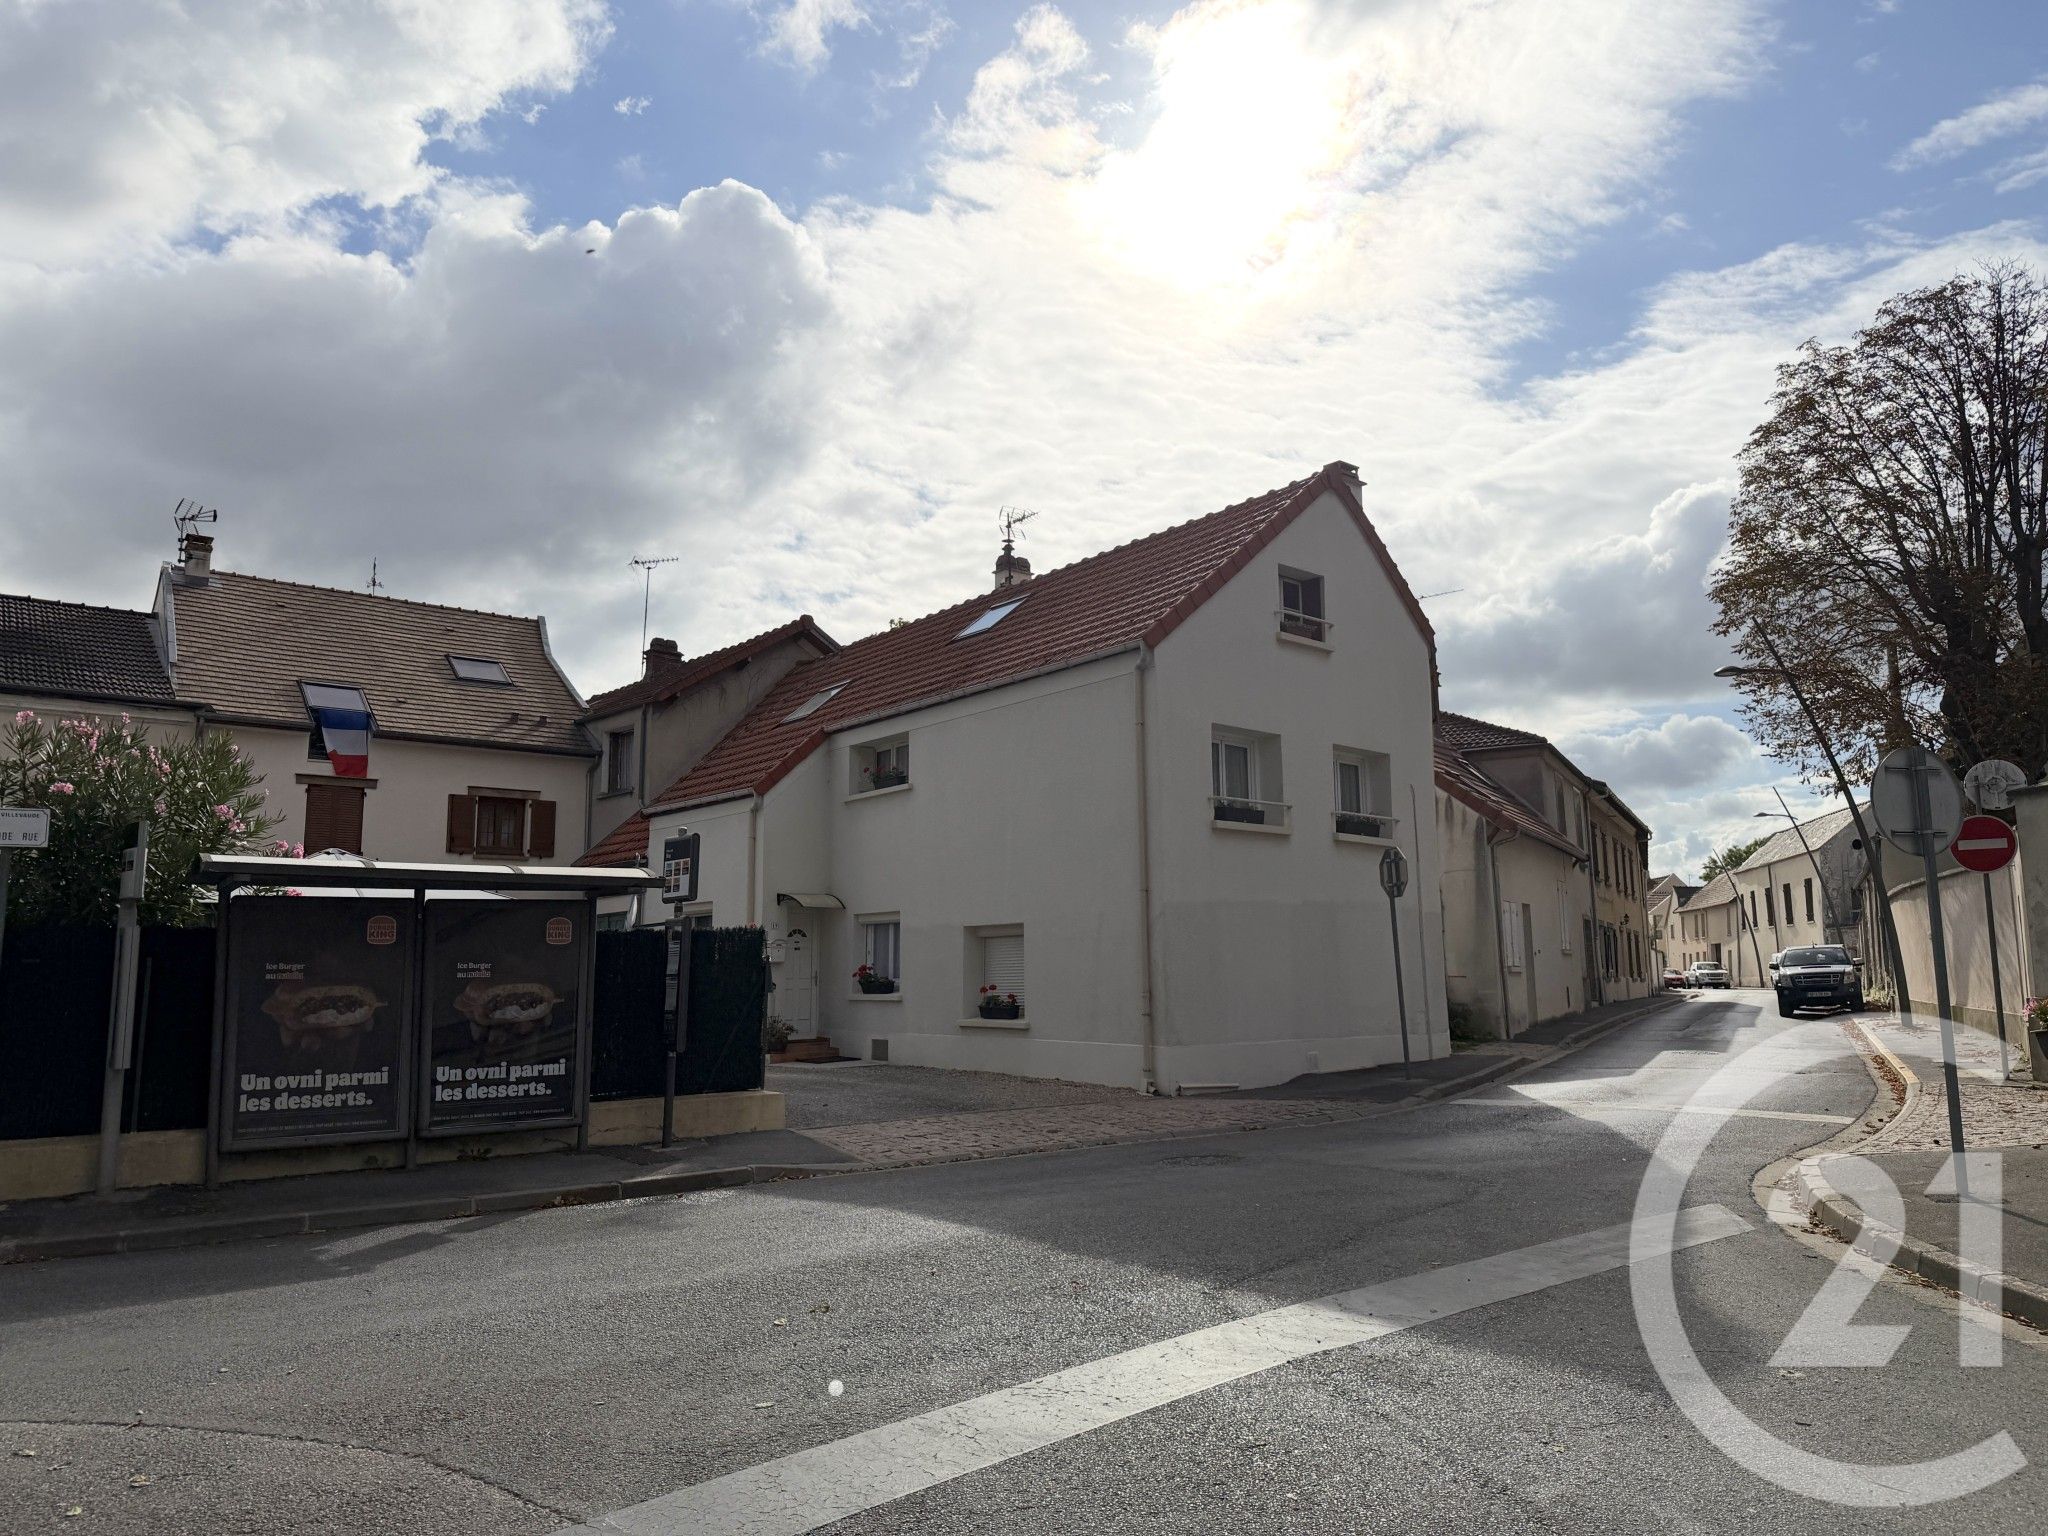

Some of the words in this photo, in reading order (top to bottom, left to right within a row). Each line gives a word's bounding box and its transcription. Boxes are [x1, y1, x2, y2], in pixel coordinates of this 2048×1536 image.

[0, 832, 13, 841] DE
[22, 832, 39, 842] RUE
[369, 931, 395, 939] KING
[548, 931, 571, 939] KING
[266, 962, 278, 970] Ice
[279, 962, 306, 972] Burger
[469, 962, 492, 970] Burger
[436, 1065, 463, 1082] Un
[465, 1061, 507, 1080] ovni
[509, 1058, 566, 1082] parmi
[240, 1073, 271, 1091] Un
[274, 1068, 322, 1089] ovni
[325, 1066, 389, 1091] parmi
[435, 1084, 463, 1102] les
[465, 1081, 552, 1100] desserts.
[239, 1094, 271, 1112] les
[274, 1091, 374, 1110] desserts.
